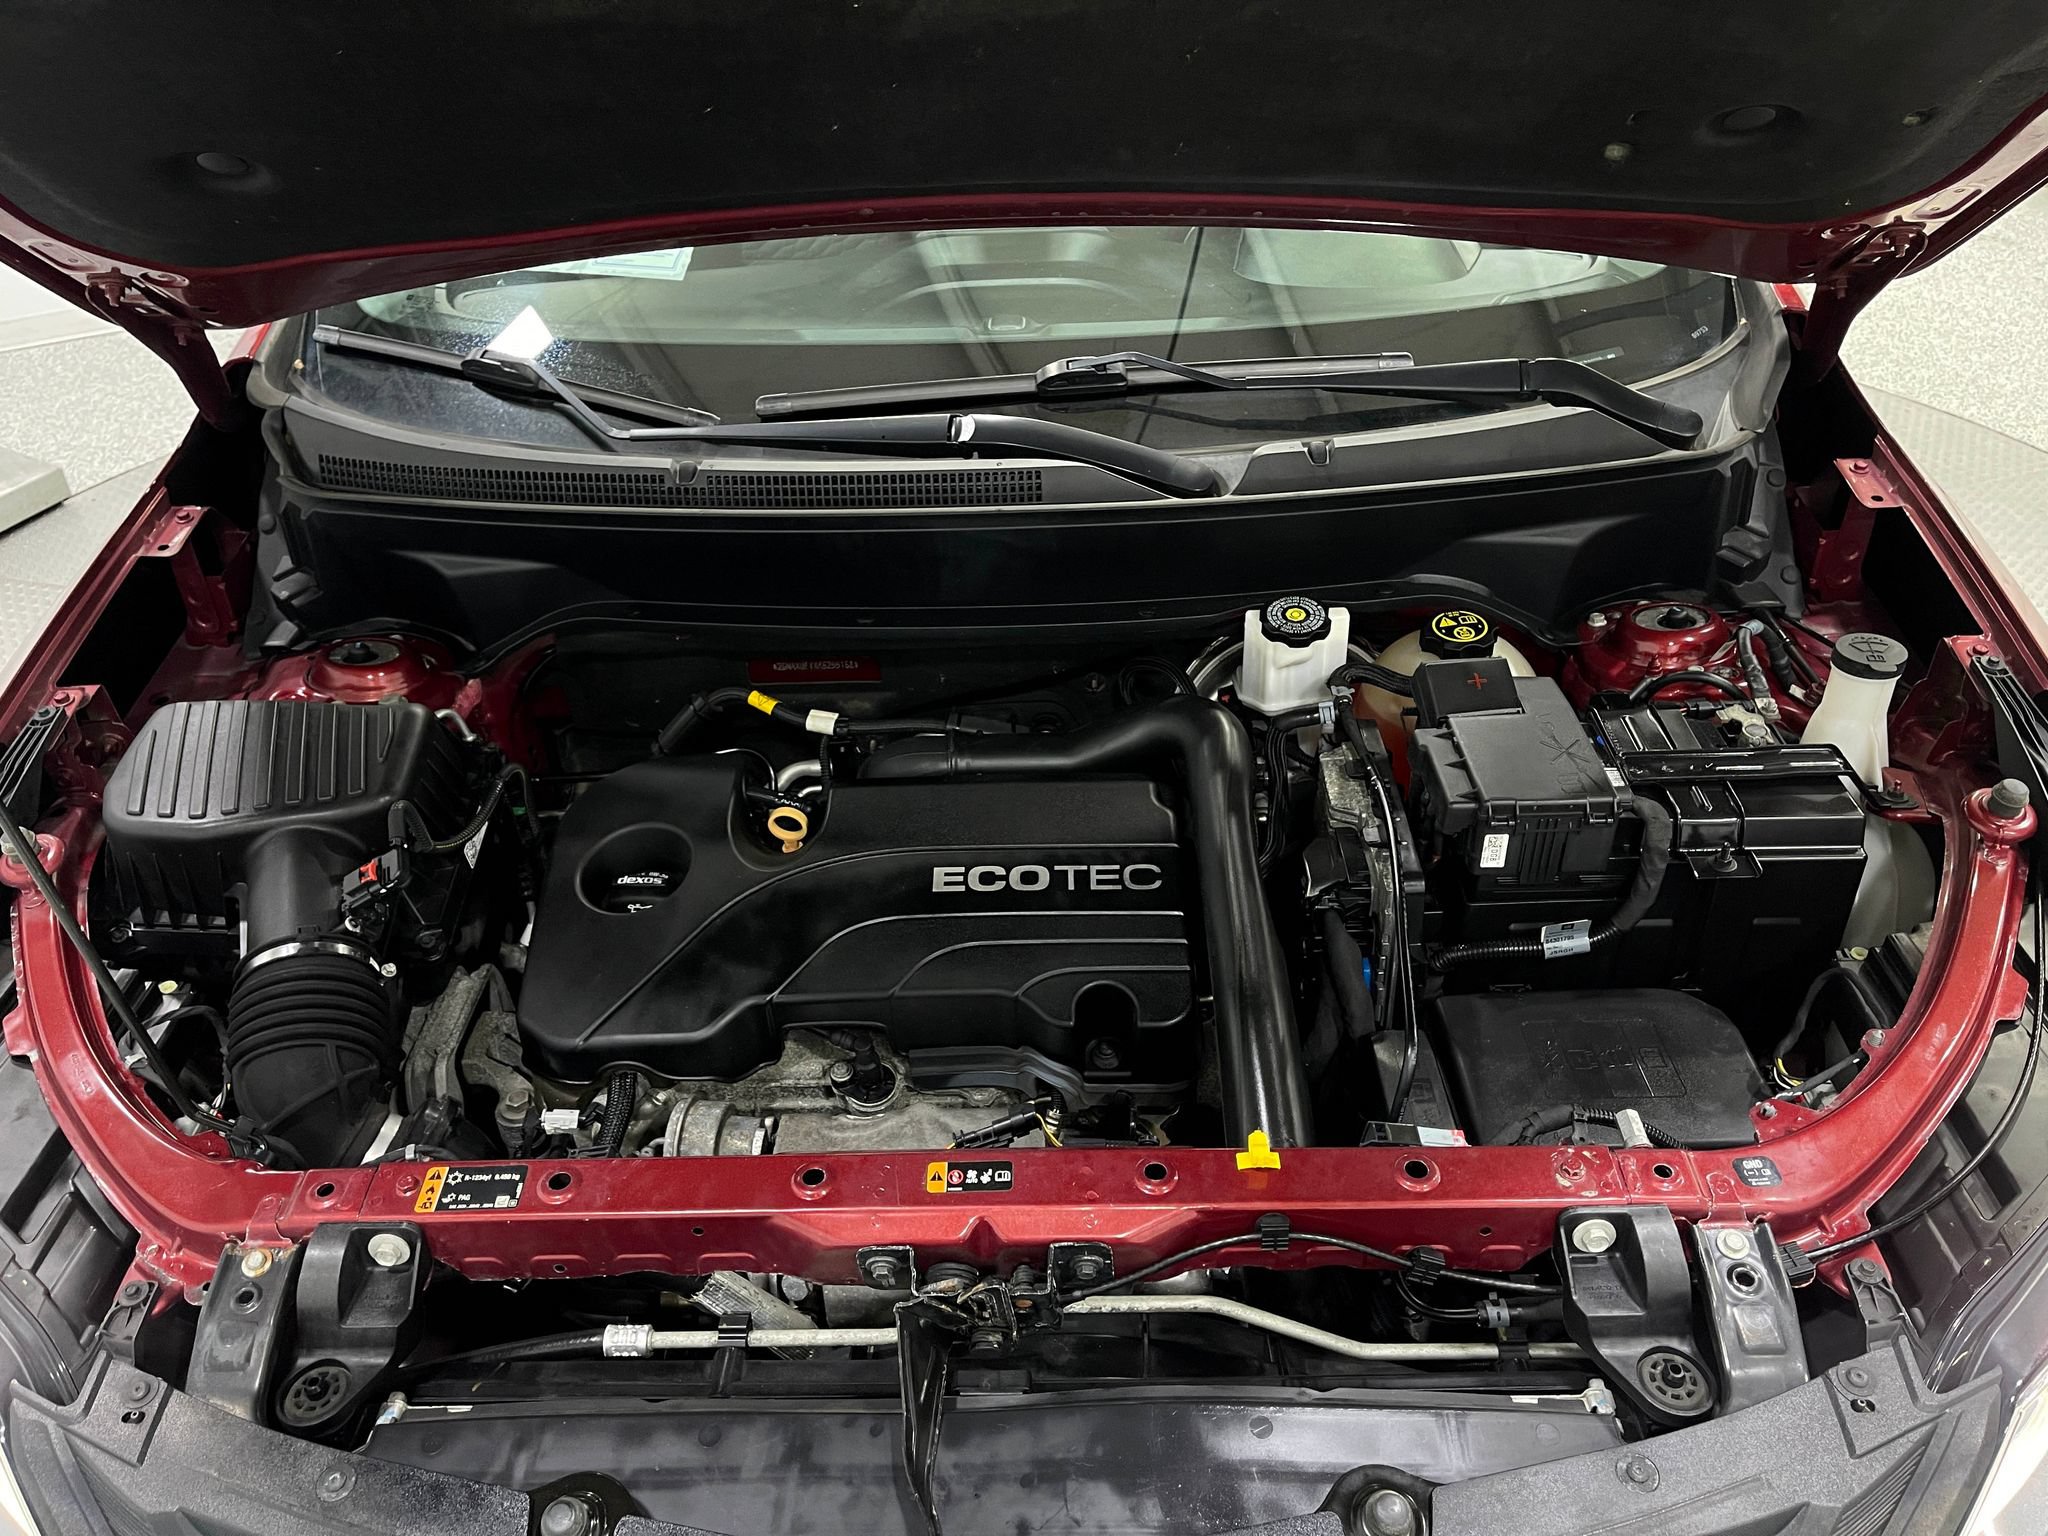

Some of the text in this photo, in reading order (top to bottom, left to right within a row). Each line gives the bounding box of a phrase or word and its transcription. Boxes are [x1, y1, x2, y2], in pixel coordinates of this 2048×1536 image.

[617, 875, 662, 884] dexos
[932, 863, 1162, 892] ECOTEC
[1742, 1159, 1764, 1169] GND
